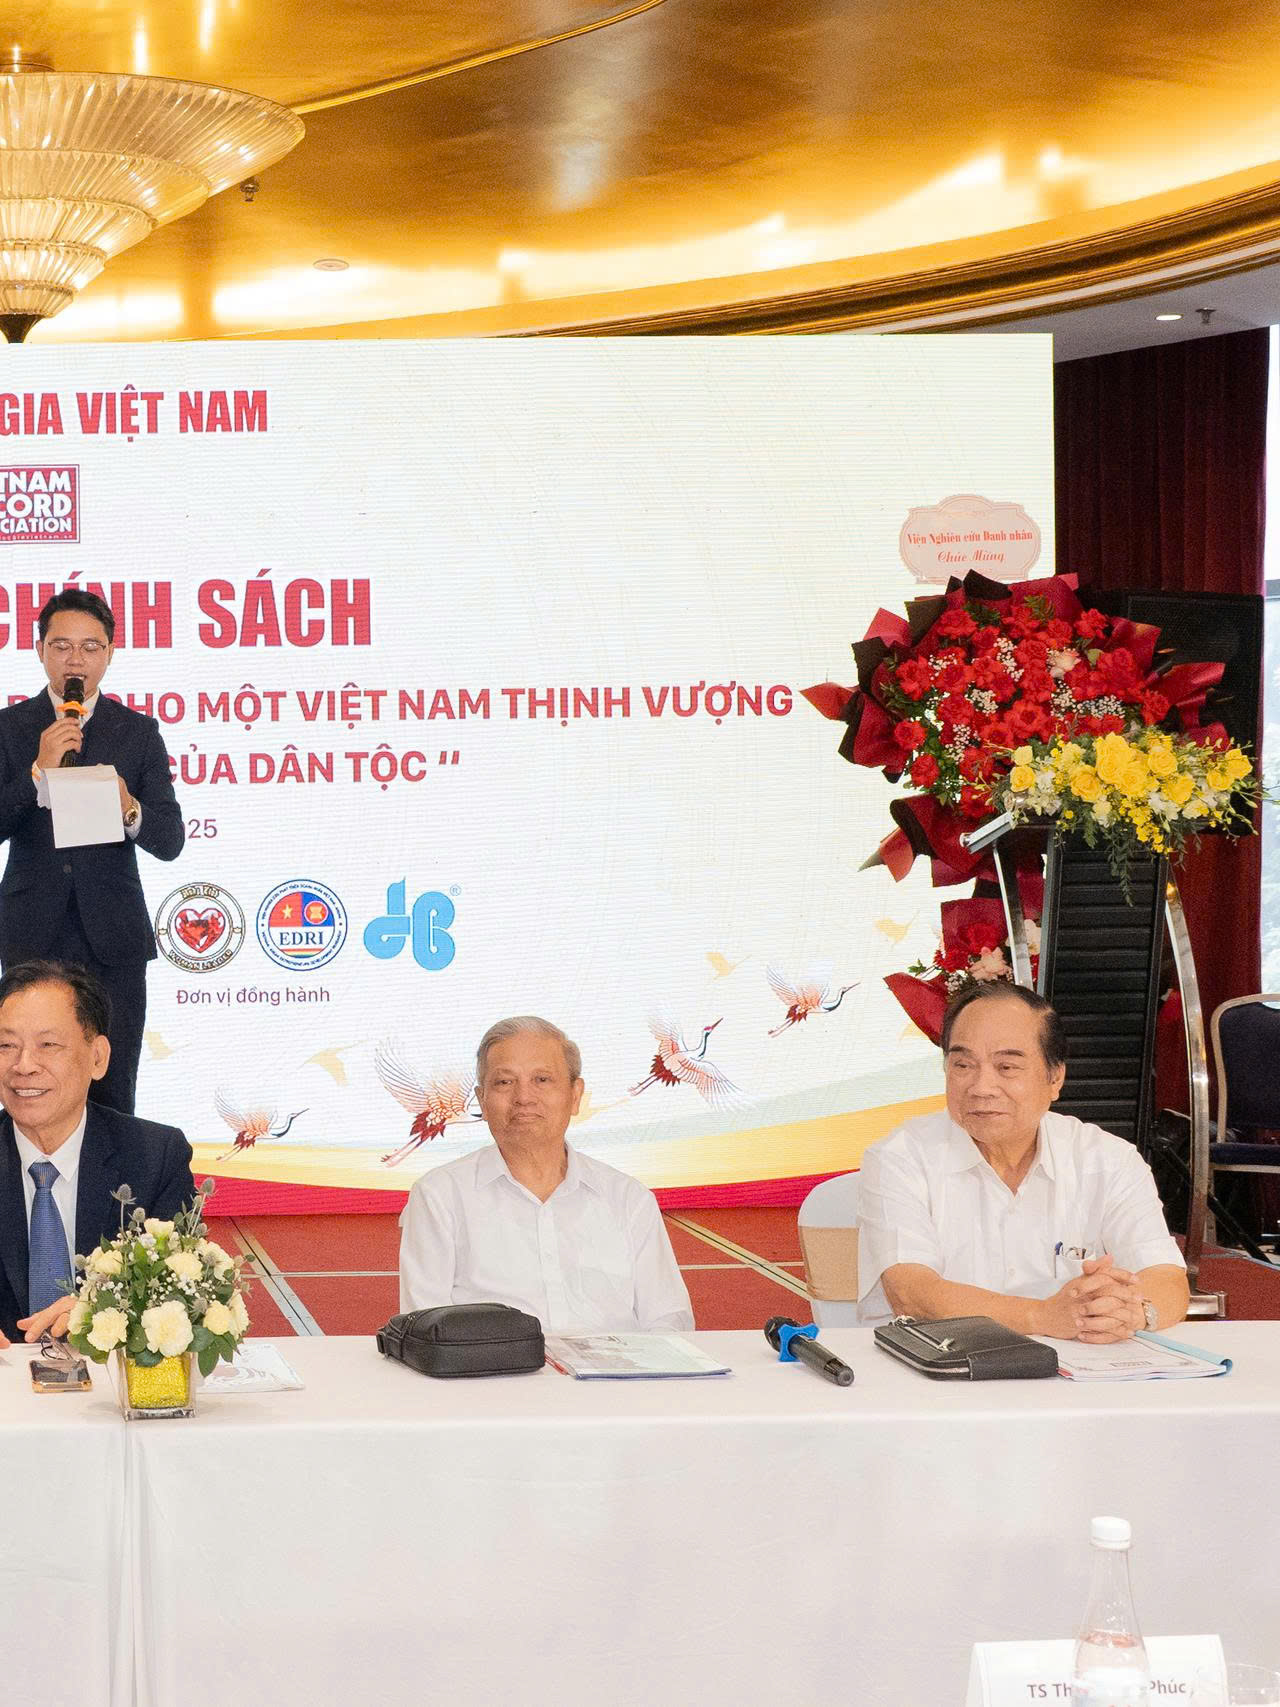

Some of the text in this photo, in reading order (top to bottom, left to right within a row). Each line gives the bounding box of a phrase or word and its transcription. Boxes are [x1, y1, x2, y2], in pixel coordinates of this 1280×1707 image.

[76, 384, 164, 442] VIỆT
[179, 390, 267, 433] NAM
[198, 567, 372, 649] SÁCH
[198, 684, 286, 731] MỘT
[296, 682, 387, 730] VIỆT
[399, 689, 490, 721] NAM
[501, 685, 630, 727] THỊNH
[642, 680, 793, 726] VƯỢNG
[250, 745, 333, 784] DÂN
[345, 743, 426, 791] TỘC
[279, 931, 323, 946] EDRI
[176, 986, 330, 1007] Đơn vị đồng hành
[1027, 1684, 1048, 1699] TS
